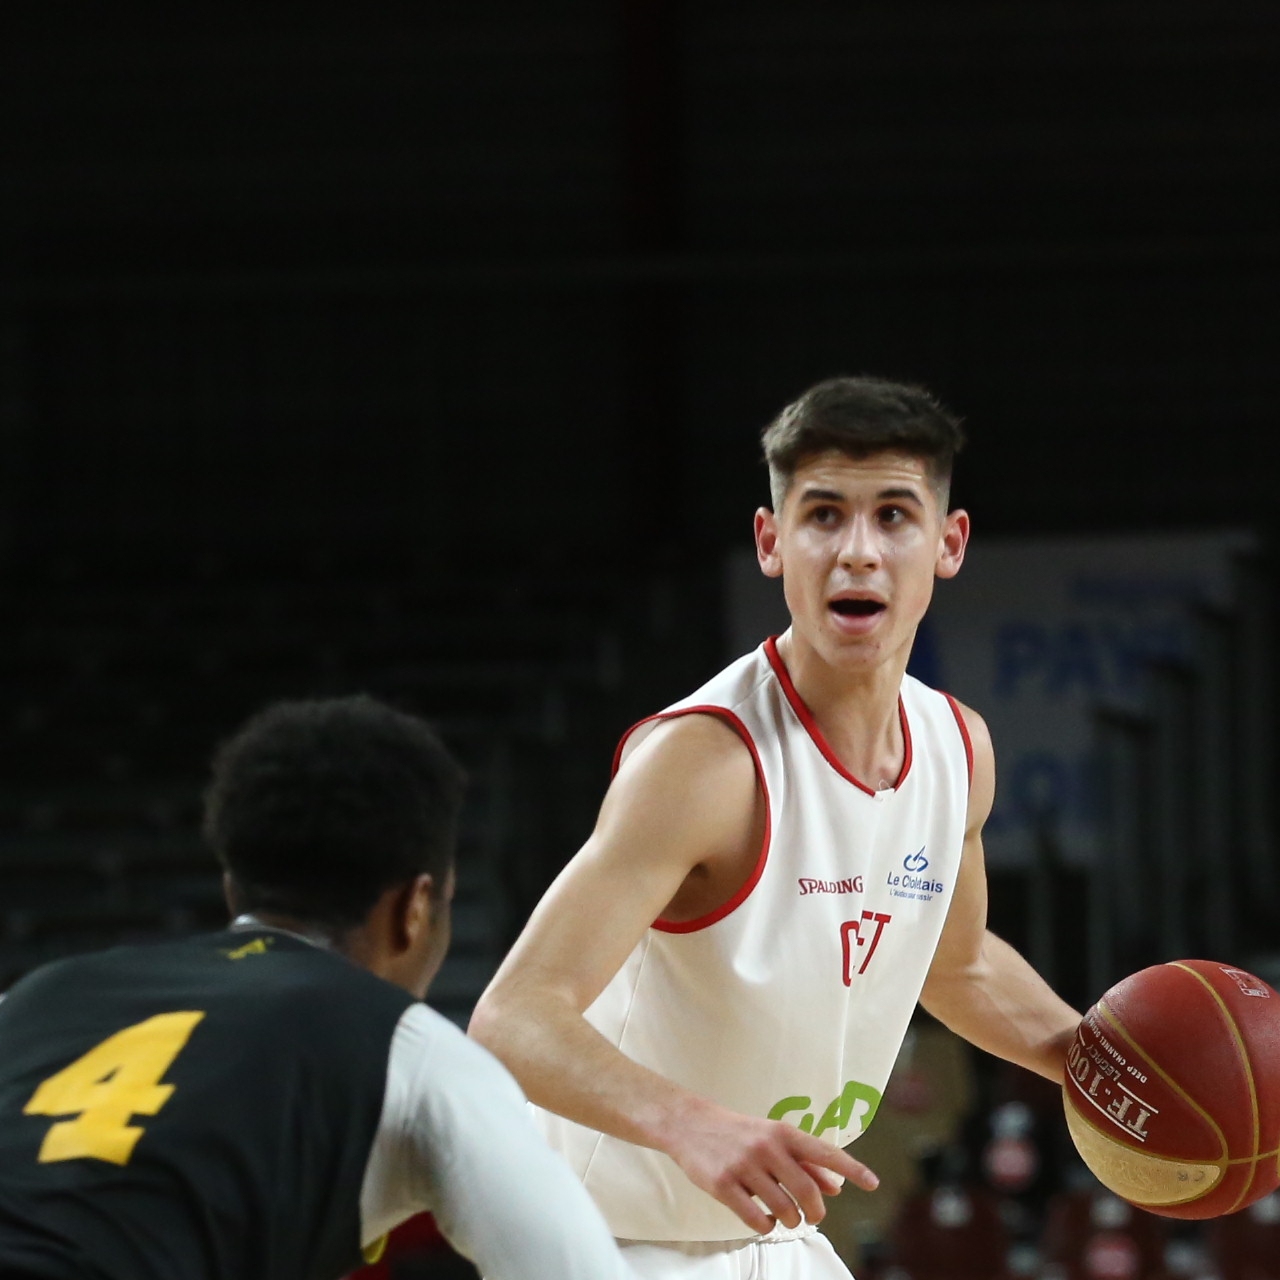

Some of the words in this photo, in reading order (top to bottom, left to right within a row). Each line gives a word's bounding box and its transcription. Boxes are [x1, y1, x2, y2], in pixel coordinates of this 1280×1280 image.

[797, 874, 864, 896] SPALDING
[887, 871, 900, 886] Le
[1086, 1044, 1122, 1082] LEGACY
[1100, 1036, 1127, 1066] CHANNEL
[1126, 1065, 1148, 1084] DEEP
[23, 1010, 206, 1166] 4
